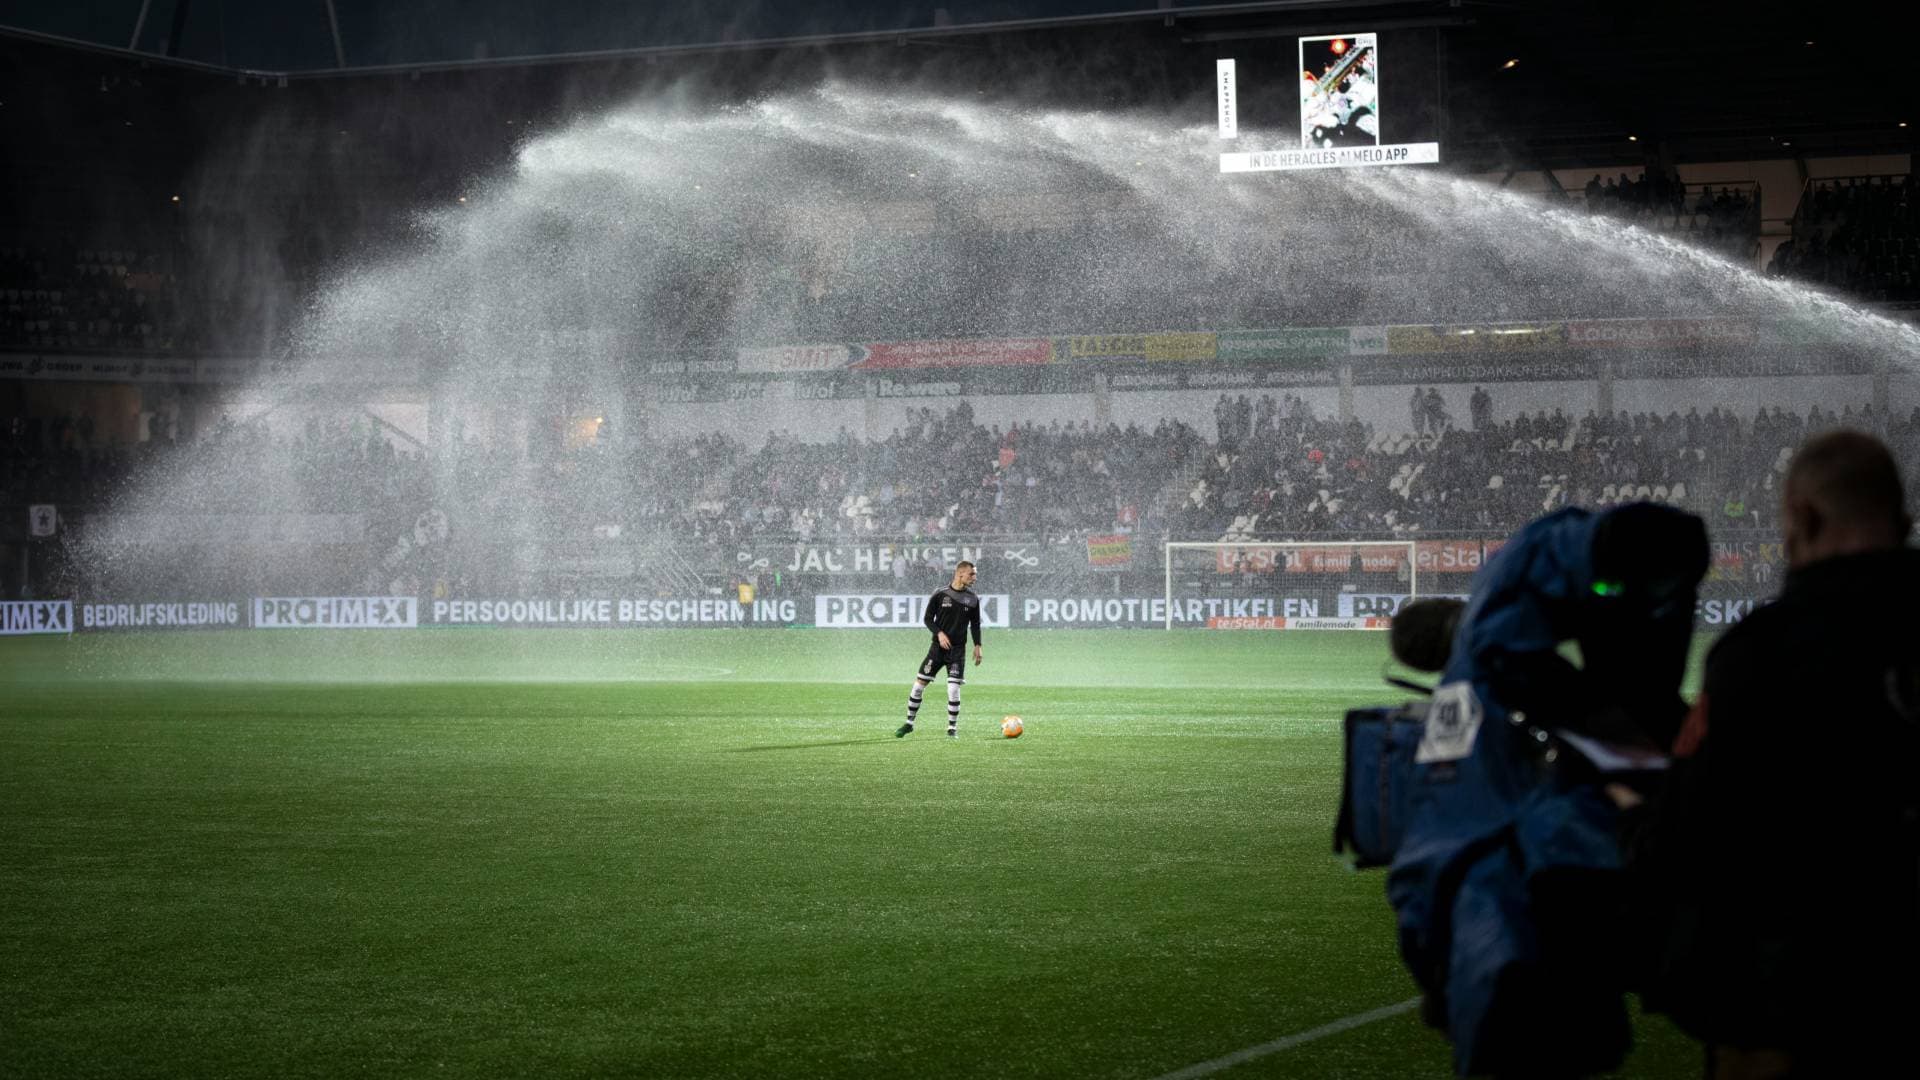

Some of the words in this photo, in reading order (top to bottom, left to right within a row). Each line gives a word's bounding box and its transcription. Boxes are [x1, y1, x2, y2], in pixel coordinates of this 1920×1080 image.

[1250, 154, 1261, 167] IN
[1264, 154, 1277, 167] DE
[1281, 151, 1336, 167] HERACLES
[1385, 148, 1409, 161] APP
[788, 547, 843, 572] JAC
[0, 603, 64, 630] IMEX
[83, 601, 238, 627] BEDRIJFSKLEDING
[262, 599, 408, 624] PROFIMEX
[433, 599, 610, 622] PERSOONLIJKE
[1295, 620, 1356, 629] familiemode
